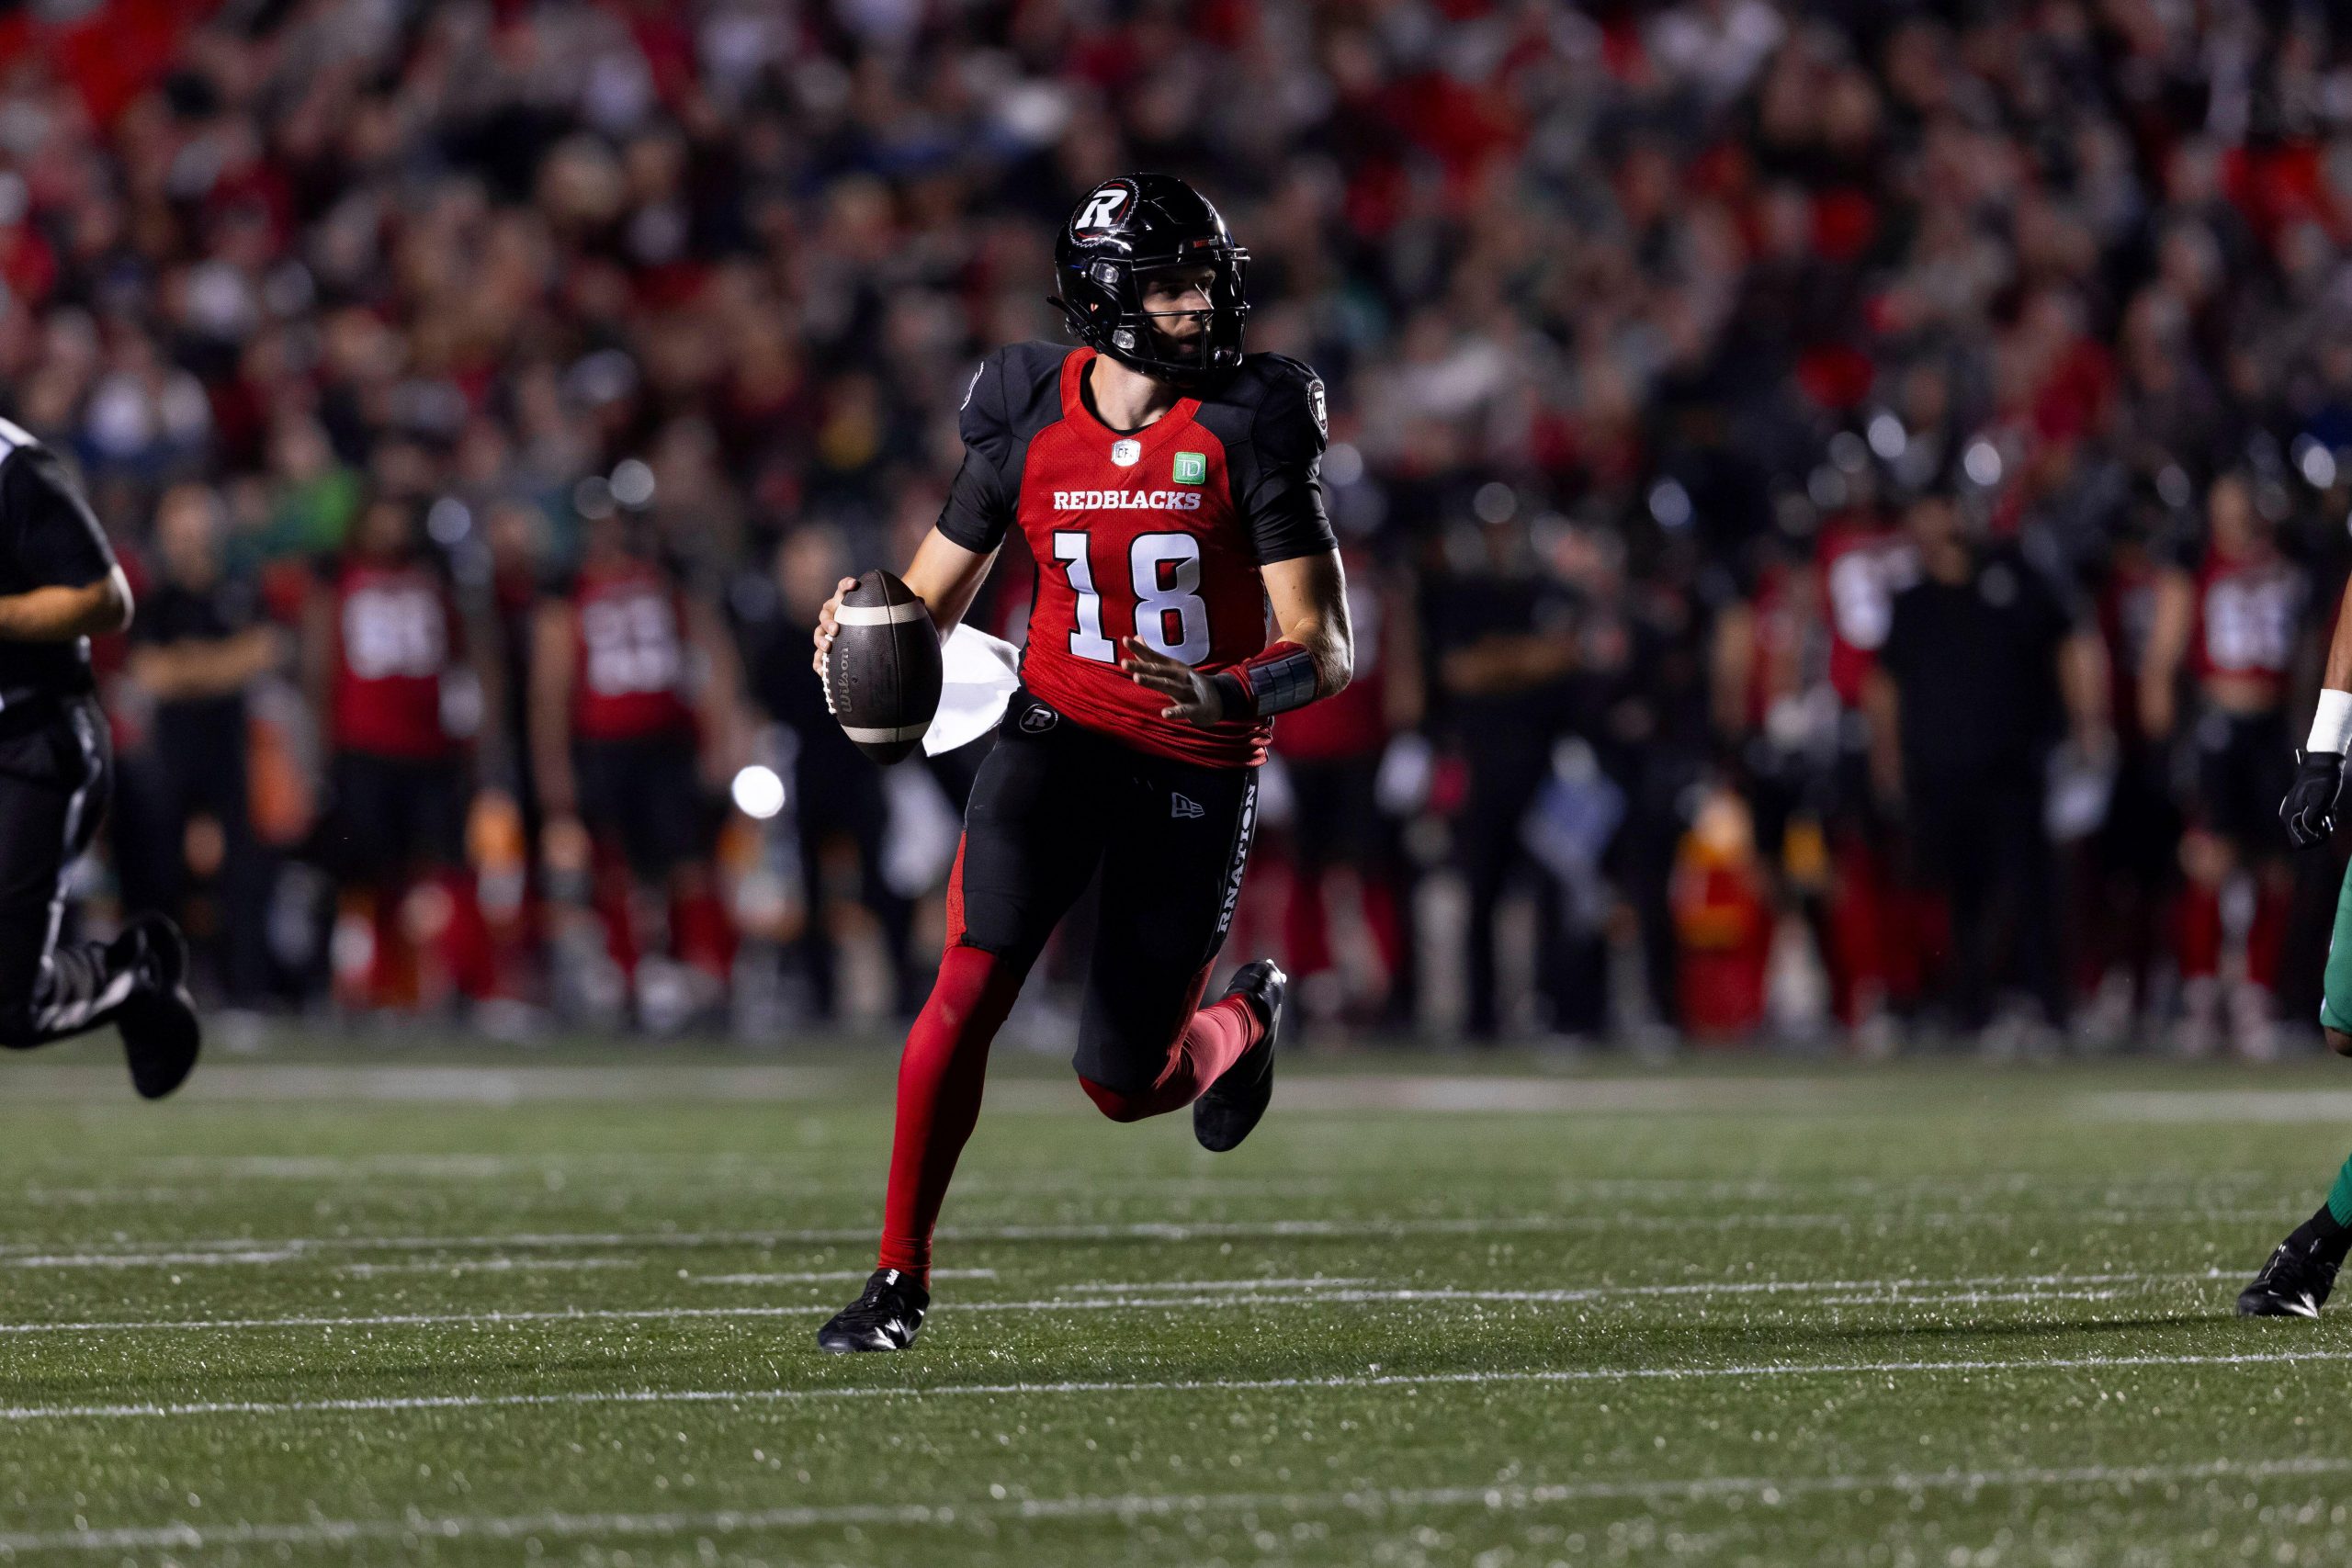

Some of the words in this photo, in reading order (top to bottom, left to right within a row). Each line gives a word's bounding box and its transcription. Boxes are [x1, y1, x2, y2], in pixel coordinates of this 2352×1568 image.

[1075, 189, 1128, 231] R
[1176, 459, 1202, 477] TD
[1054, 490, 1202, 510] REDBLACKS
[1054, 530, 1211, 666] 18
[838, 647, 853, 713] Wilson
[1023, 708, 1052, 728] R
